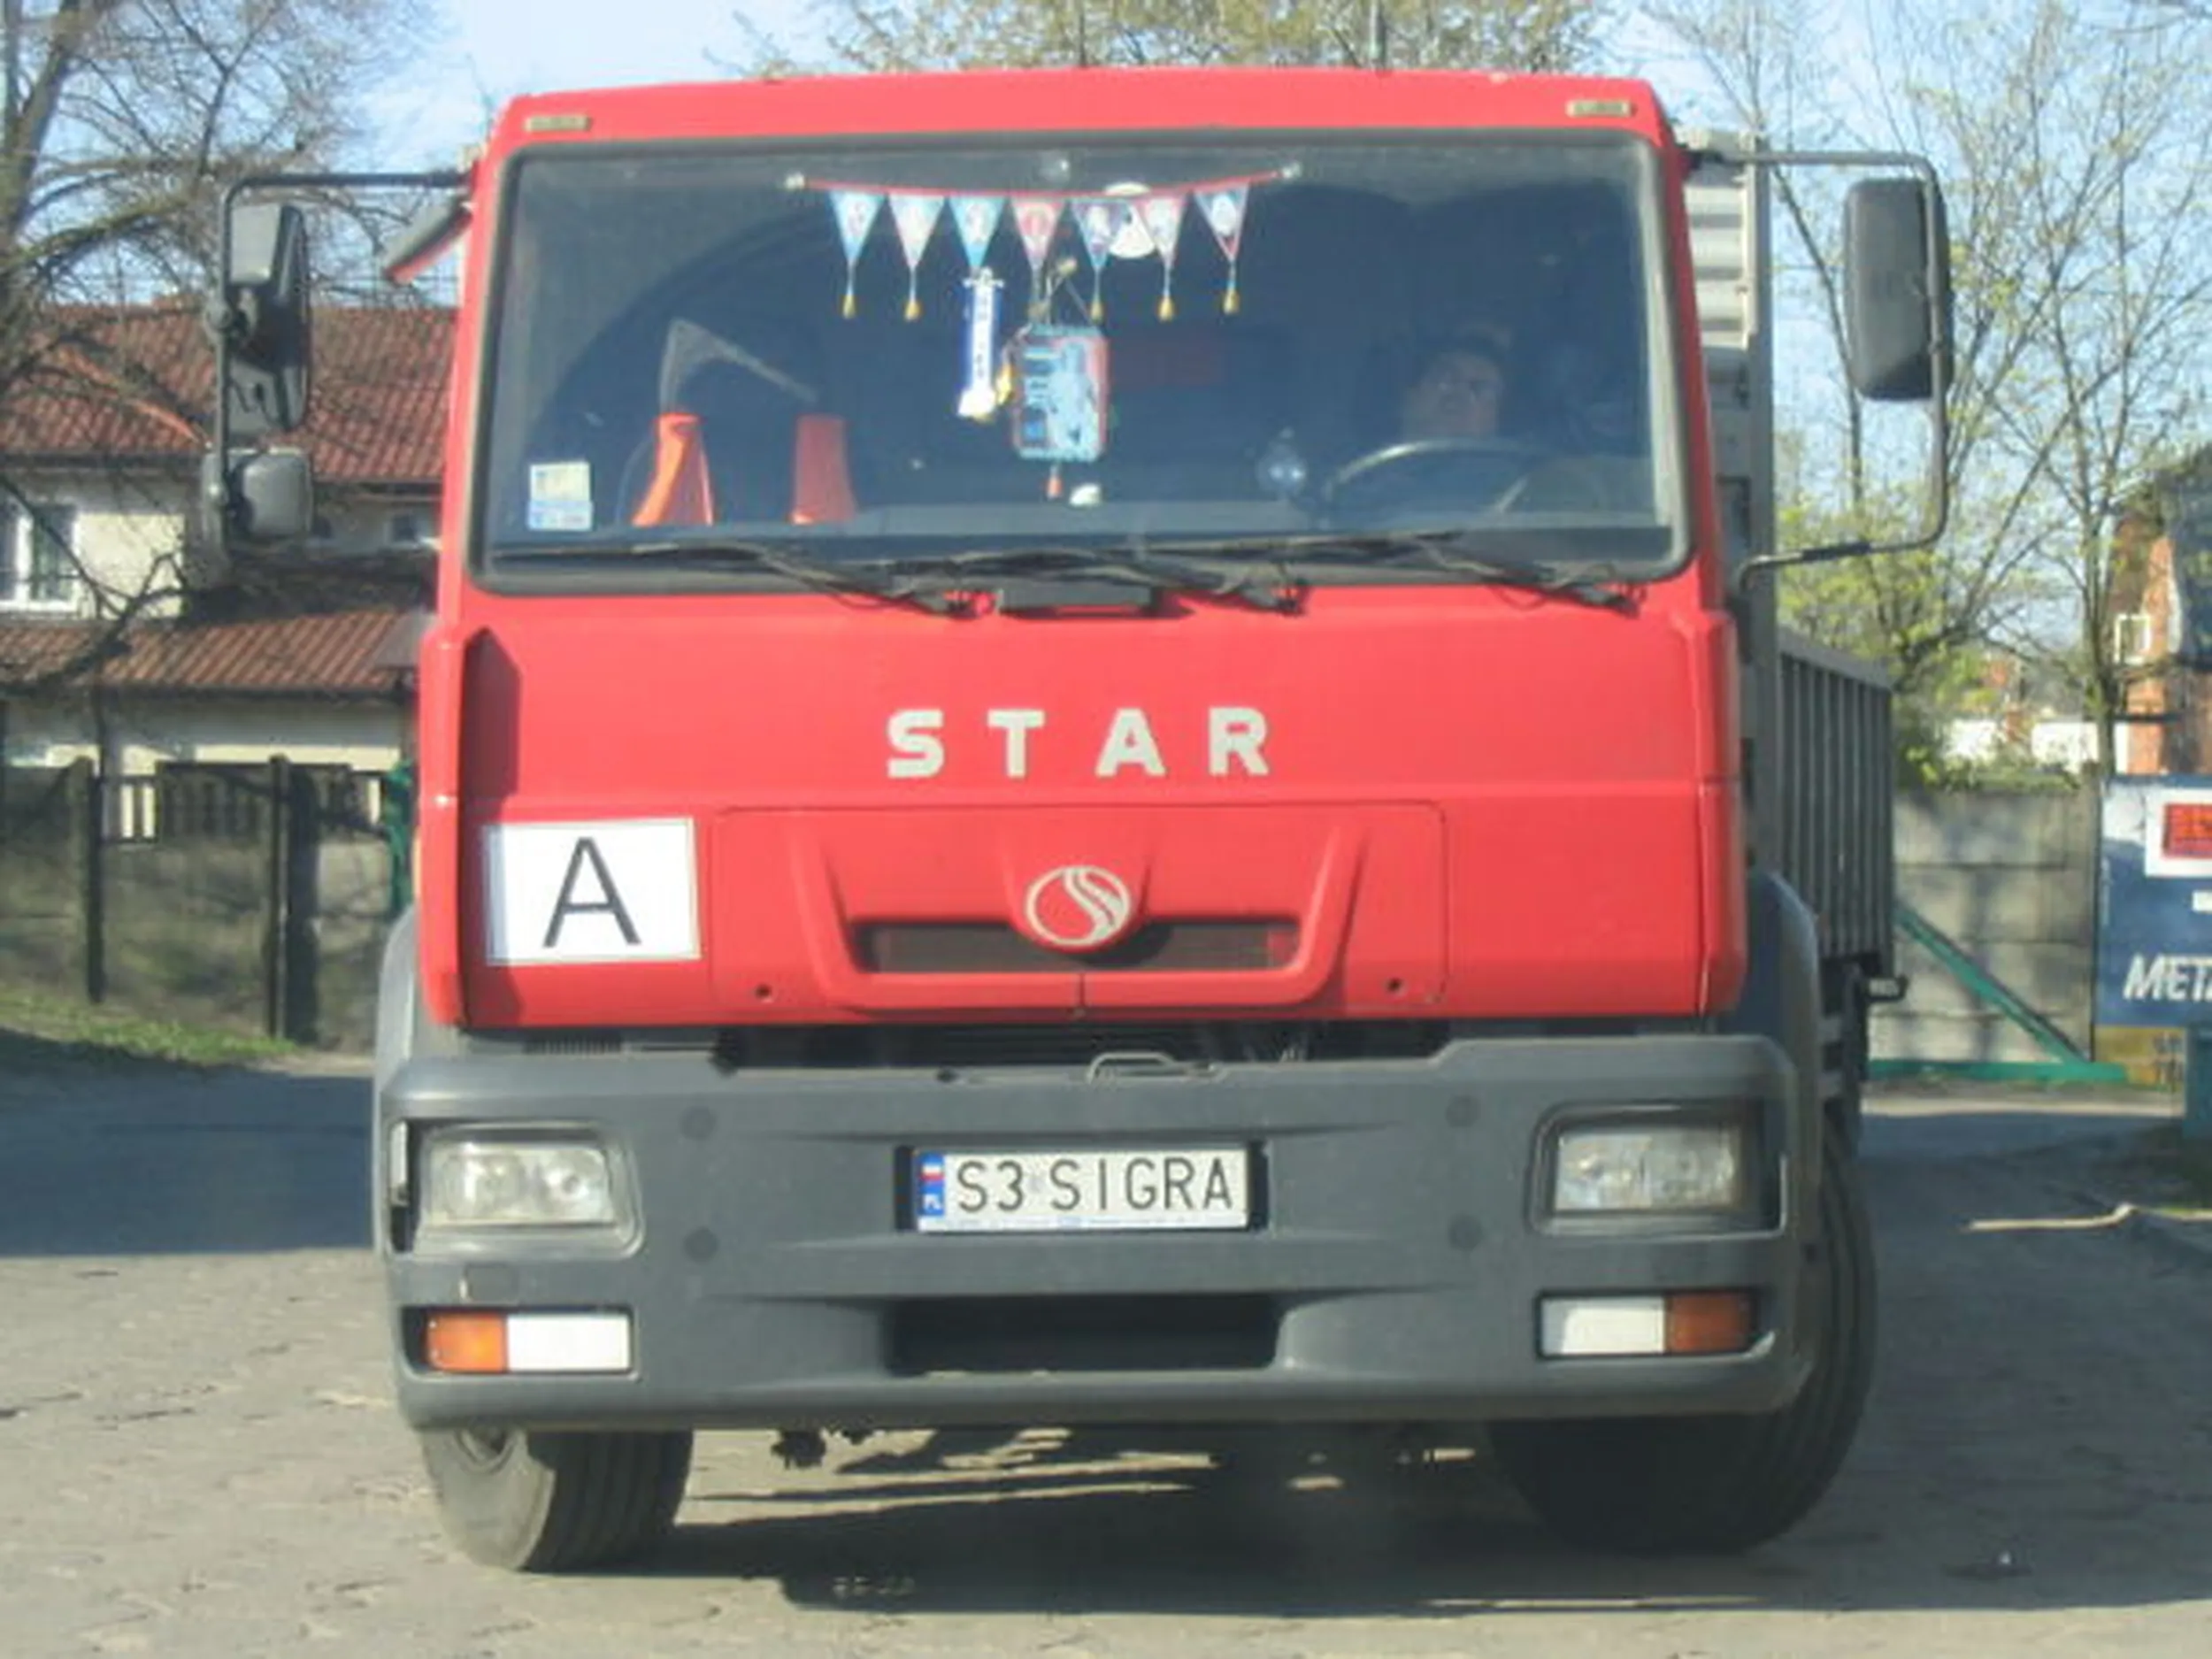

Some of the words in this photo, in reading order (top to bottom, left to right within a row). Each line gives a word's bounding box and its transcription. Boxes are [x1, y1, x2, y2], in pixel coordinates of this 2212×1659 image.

[887, 708, 1269, 779] STAR
[542, 836, 642, 948] A
[2123, 952, 2212, 1000] MET
